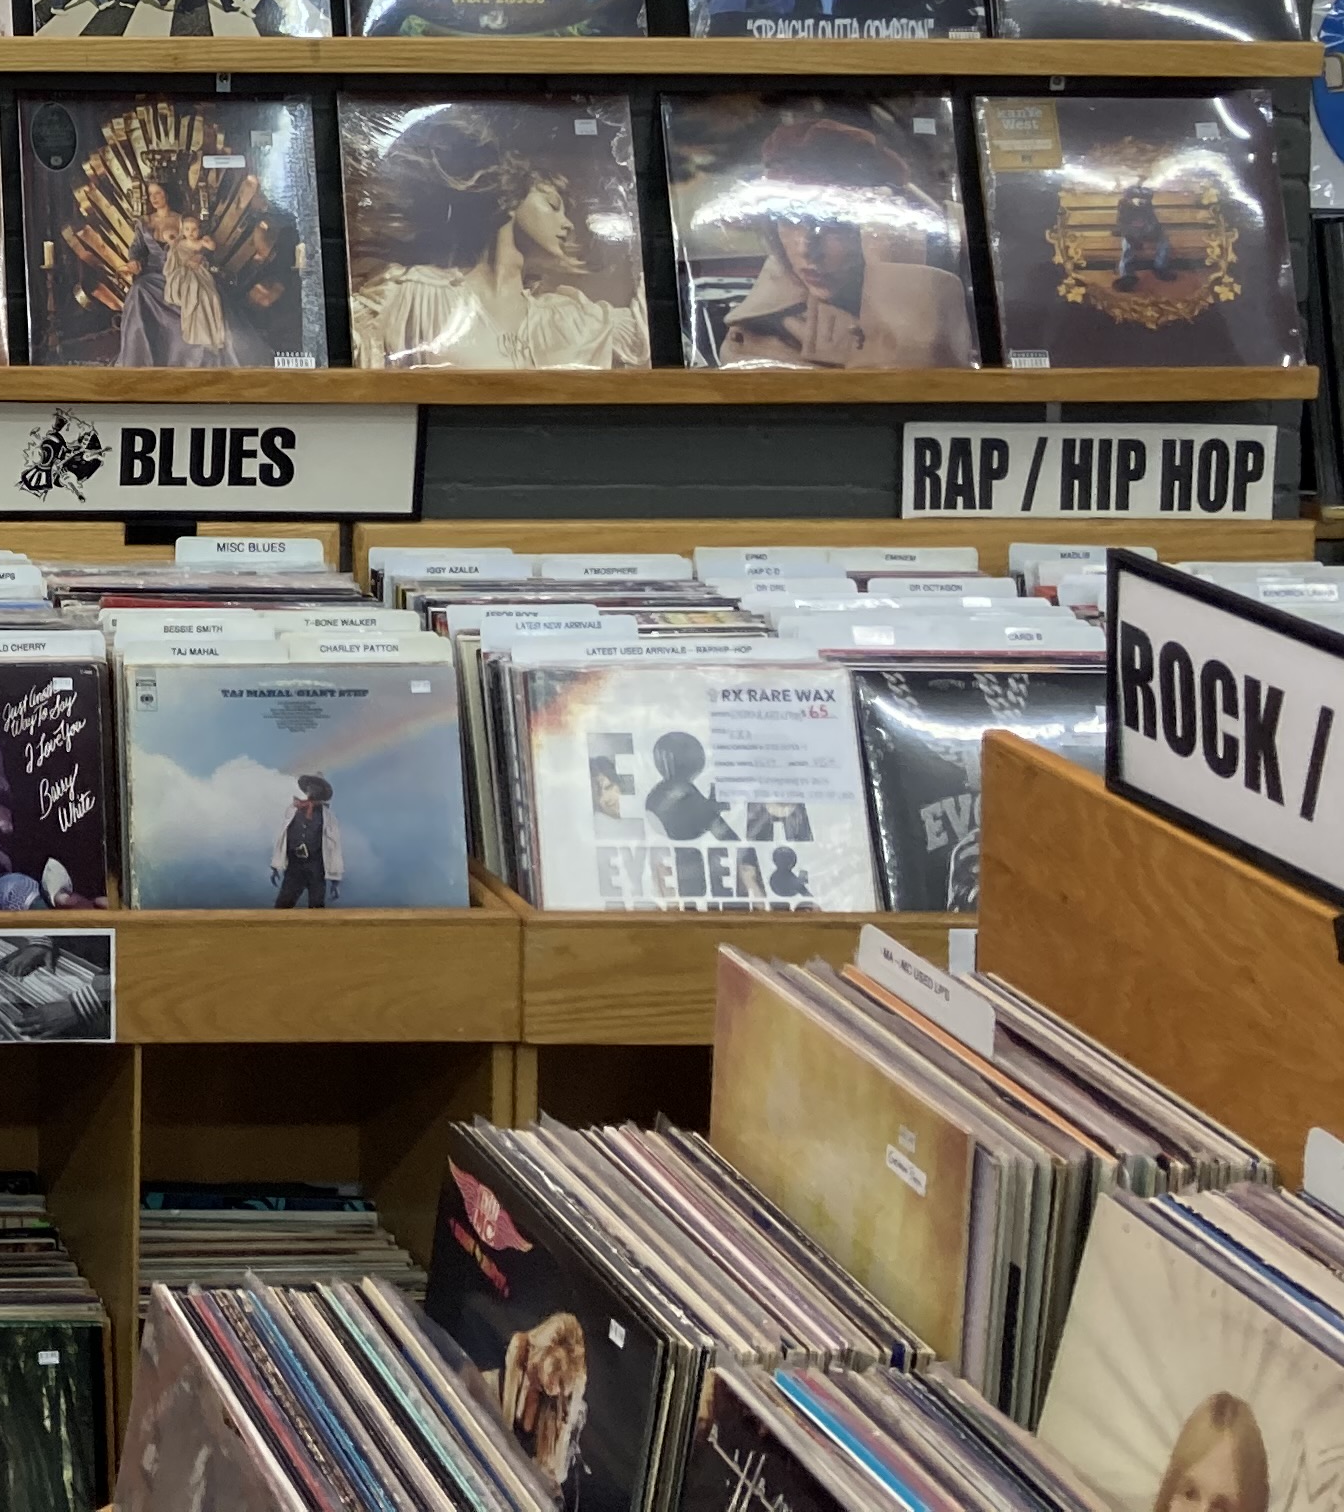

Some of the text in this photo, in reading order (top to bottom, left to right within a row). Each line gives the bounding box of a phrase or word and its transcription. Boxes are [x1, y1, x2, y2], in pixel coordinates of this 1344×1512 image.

[119, 427, 295, 487] BLUES
[914, 437, 1009, 510] RAP
[1060, 438, 1147, 510] HIP
[1160, 438, 1265, 513] HOP
[216, 543, 286, 552] MISC BLUES
[11, 643, 46, 652] CHERRY
[189, 647, 219, 656] MAHAL
[723, 690, 835, 702] RX RARE WAX
[1121, 621, 1288, 806] ROCK
[39, 763, 78, 820] Barry
[58, 790, 96, 833] White
[596, 846, 768, 897] EYEDEA
